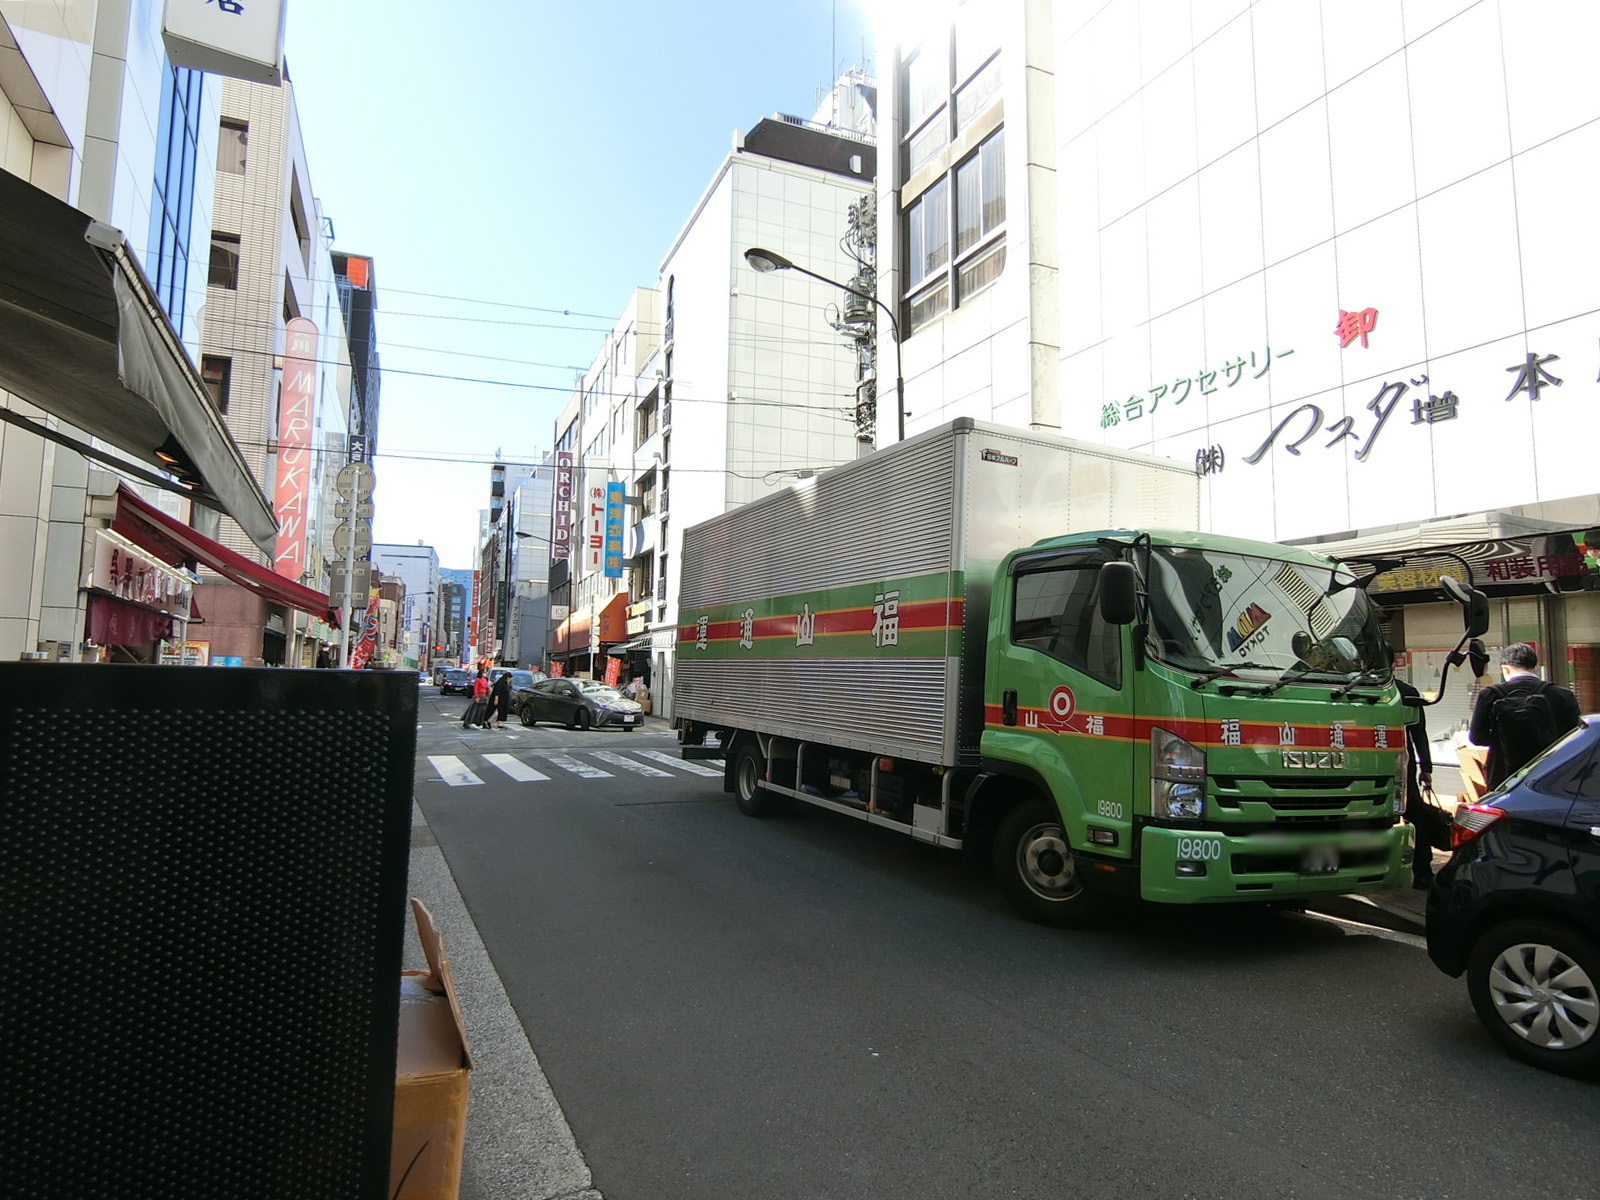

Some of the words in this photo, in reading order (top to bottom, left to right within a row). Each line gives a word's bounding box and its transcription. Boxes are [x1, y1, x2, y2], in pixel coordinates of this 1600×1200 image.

[1334, 307, 1380, 349] 卸
[1099, 345, 1295, 430] 総合アクセサリー
[276, 371, 313, 563] MARUKAWA
[556, 458, 572, 540] ORCHID
[1376, 563, 1465, 591] 美容材料
[1282, 751, 1345, 769] ISUZU
[1097, 799, 1123, 819] 19800
[1177, 838, 1221, 861] 19800
